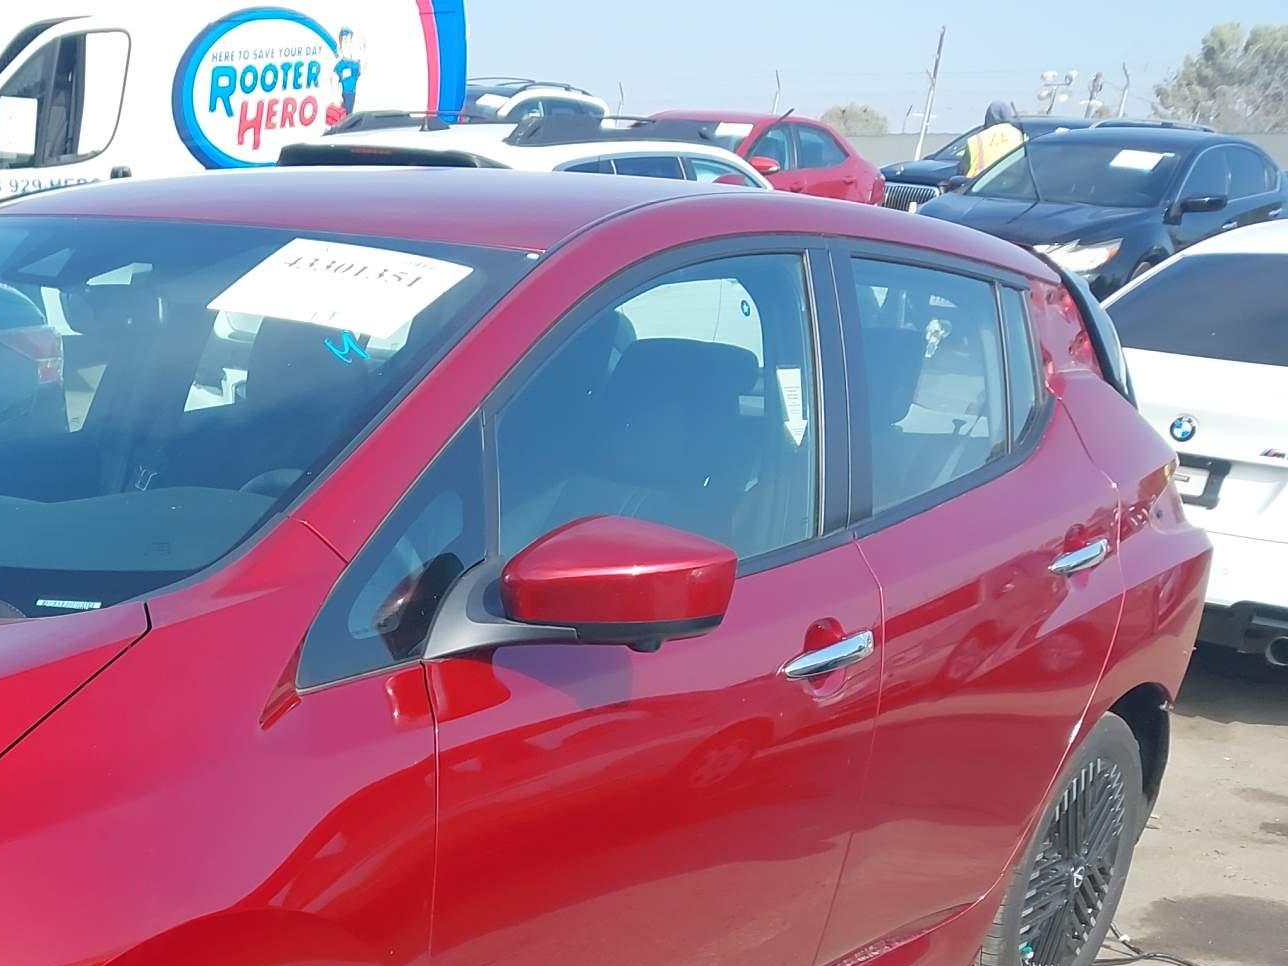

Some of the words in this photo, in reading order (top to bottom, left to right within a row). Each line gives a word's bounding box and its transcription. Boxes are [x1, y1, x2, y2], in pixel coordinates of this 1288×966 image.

[212, 51, 234, 62] HERE
[239, 50, 250, 60] TO
[253, 48, 274, 60] SAVE
[279, 46, 303, 58] YOUR
[306, 45, 323, 56] DAY
[209, 61, 321, 117] ROOTER
[237, 96, 319, 150] HERO
[10, 179, 42, 194] 929
